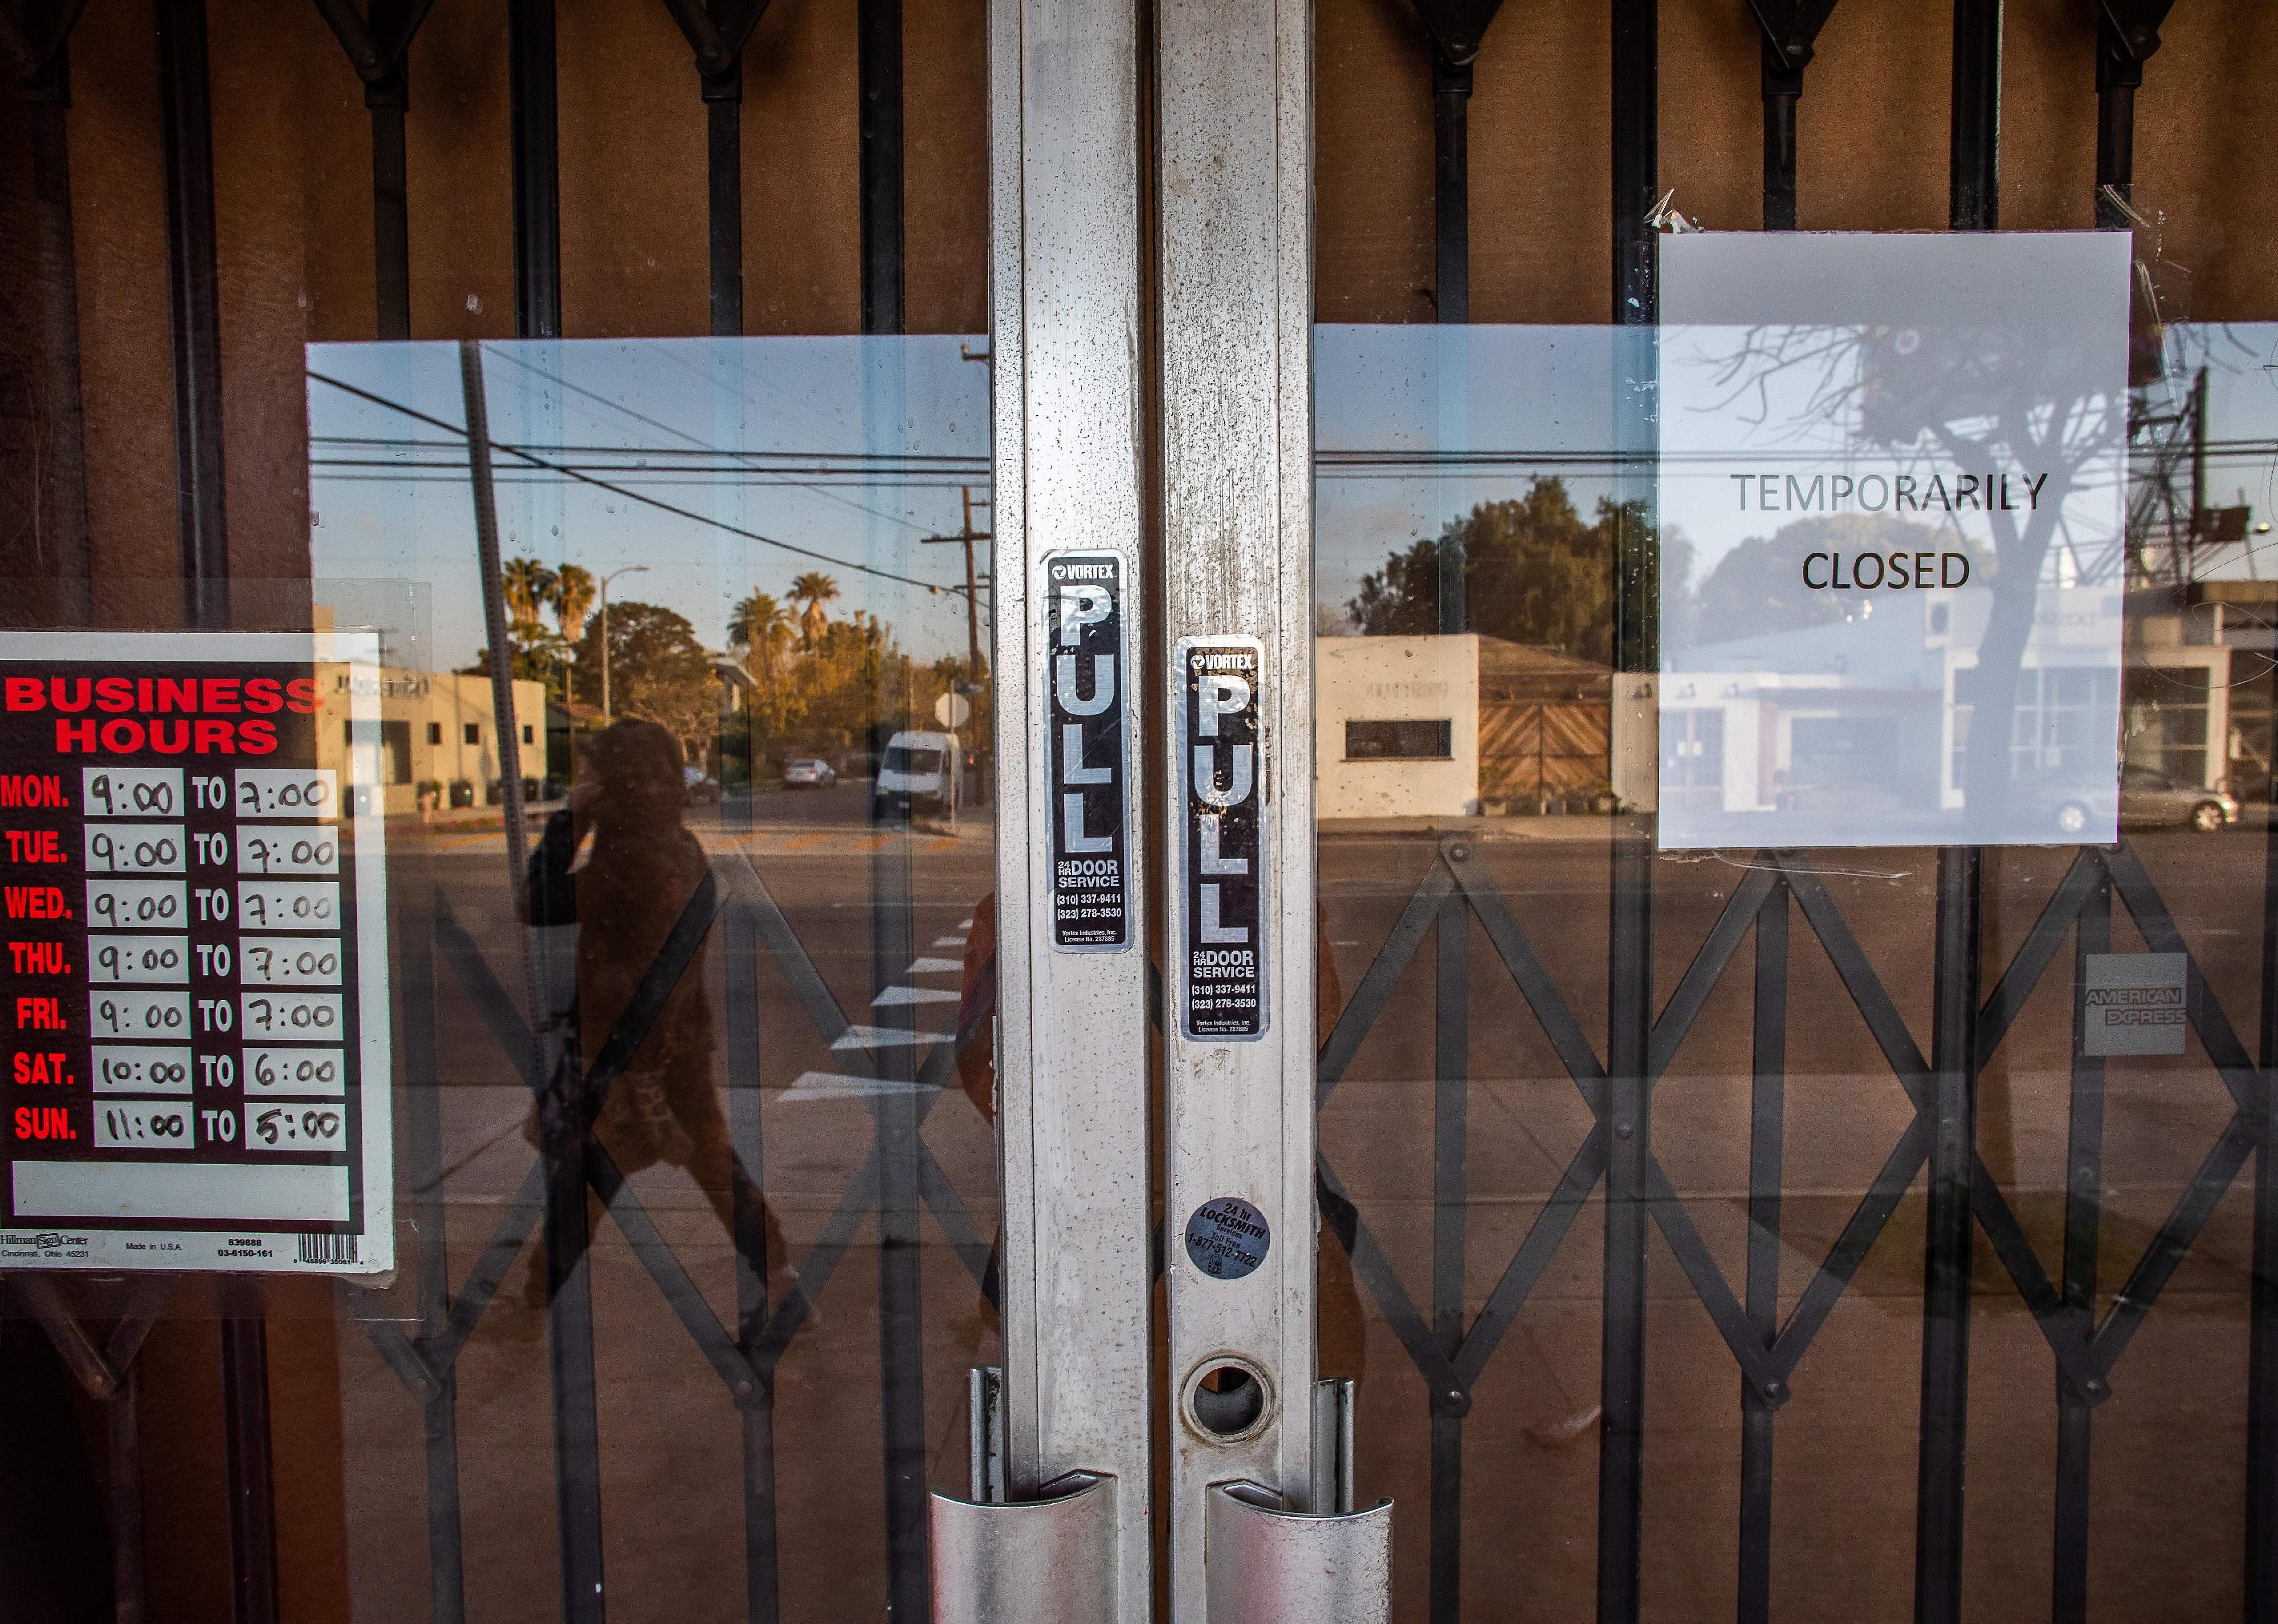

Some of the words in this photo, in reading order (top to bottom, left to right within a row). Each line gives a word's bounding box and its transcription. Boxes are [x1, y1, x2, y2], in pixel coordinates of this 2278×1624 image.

[1730, 473, 2048, 511] TEMPORARILY
[1067, 564, 1114, 579] VORTEX
[1802, 552, 1970, 589] CLOSED
[1207, 654, 1252, 670] VORTEX
[5, 678, 325, 713] BUSINESS
[1057, 585, 1114, 853] PULL
[56, 719, 278, 754] HOURS
[0, 774, 69, 807] MON.
[92, 774, 173, 815] 9:00
[192, 776, 226, 809] TO
[239, 780, 329, 813] 7:00
[1194, 675, 1252, 944] PULL
[5, 831, 67, 863] TUE.
[92, 833, 177, 871] 9:00
[194, 833, 228, 865] TO
[248, 839, 334, 873] 7:00
[1071, 860, 1118, 876] DOOR
[1058, 876, 1120, 888] SERVICE
[4, 887, 72, 919] WED.
[95, 893, 177, 927] 9:00
[195, 888, 230, 921] TO
[245, 894, 331, 925] 7:00
[1057, 894, 1079, 906] (310)
[1081, 893, 1120, 904] 337-9411
[1058, 908, 1079, 920] (323)
[1081, 908, 1122, 917] 278-3530
[9, 942, 71, 973] THU.
[99, 946, 179, 980] 9:00
[197, 944, 230, 976] TO
[248, 947, 337, 981] 7:00
[1207, 950, 1253, 965] DOOR
[1193, 966, 1254, 978] SERVICE
[1192, 984, 1213, 996] (310)
[1215, 984, 1255, 993] 337-9411
[2085, 988, 2182, 1006] AMERICAN
[1192, 998, 1213, 1010] (323)
[1215, 998, 1256, 1008] 278-3530
[17, 997, 67, 1029] FRI.
[100, 1000, 182, 1033] 9:00
[198, 1000, 233, 1032] TO
[248, 999, 335, 1031] 7:00
[14, 1052, 74, 1084] SAT.
[102, 1058, 186, 1084] 10:00
[200, 1055, 234, 1087] TO
[255, 1053, 335, 1086] 6:00
[15, 1107, 76, 1139] SUN.
[107, 1108, 184, 1140] 11:00
[202, 1110, 235, 1142] TO
[256, 1108, 340, 1145] 5:00
[1224, 1203, 1238, 1215] 24
[1240, 1209, 1252, 1221] hr
[1200, 1207, 1266, 1239] LOCKSMITH
[1216, 1225, 1244, 1239] Services
[0, 1234, 36, 1245] Hillman
[39, 1236, 58, 1247] Sign
[60, 1235, 88, 1245] Center
[1212, 1233, 1224, 1242] Toll
[1225, 1237, 1241, 1248] Free
